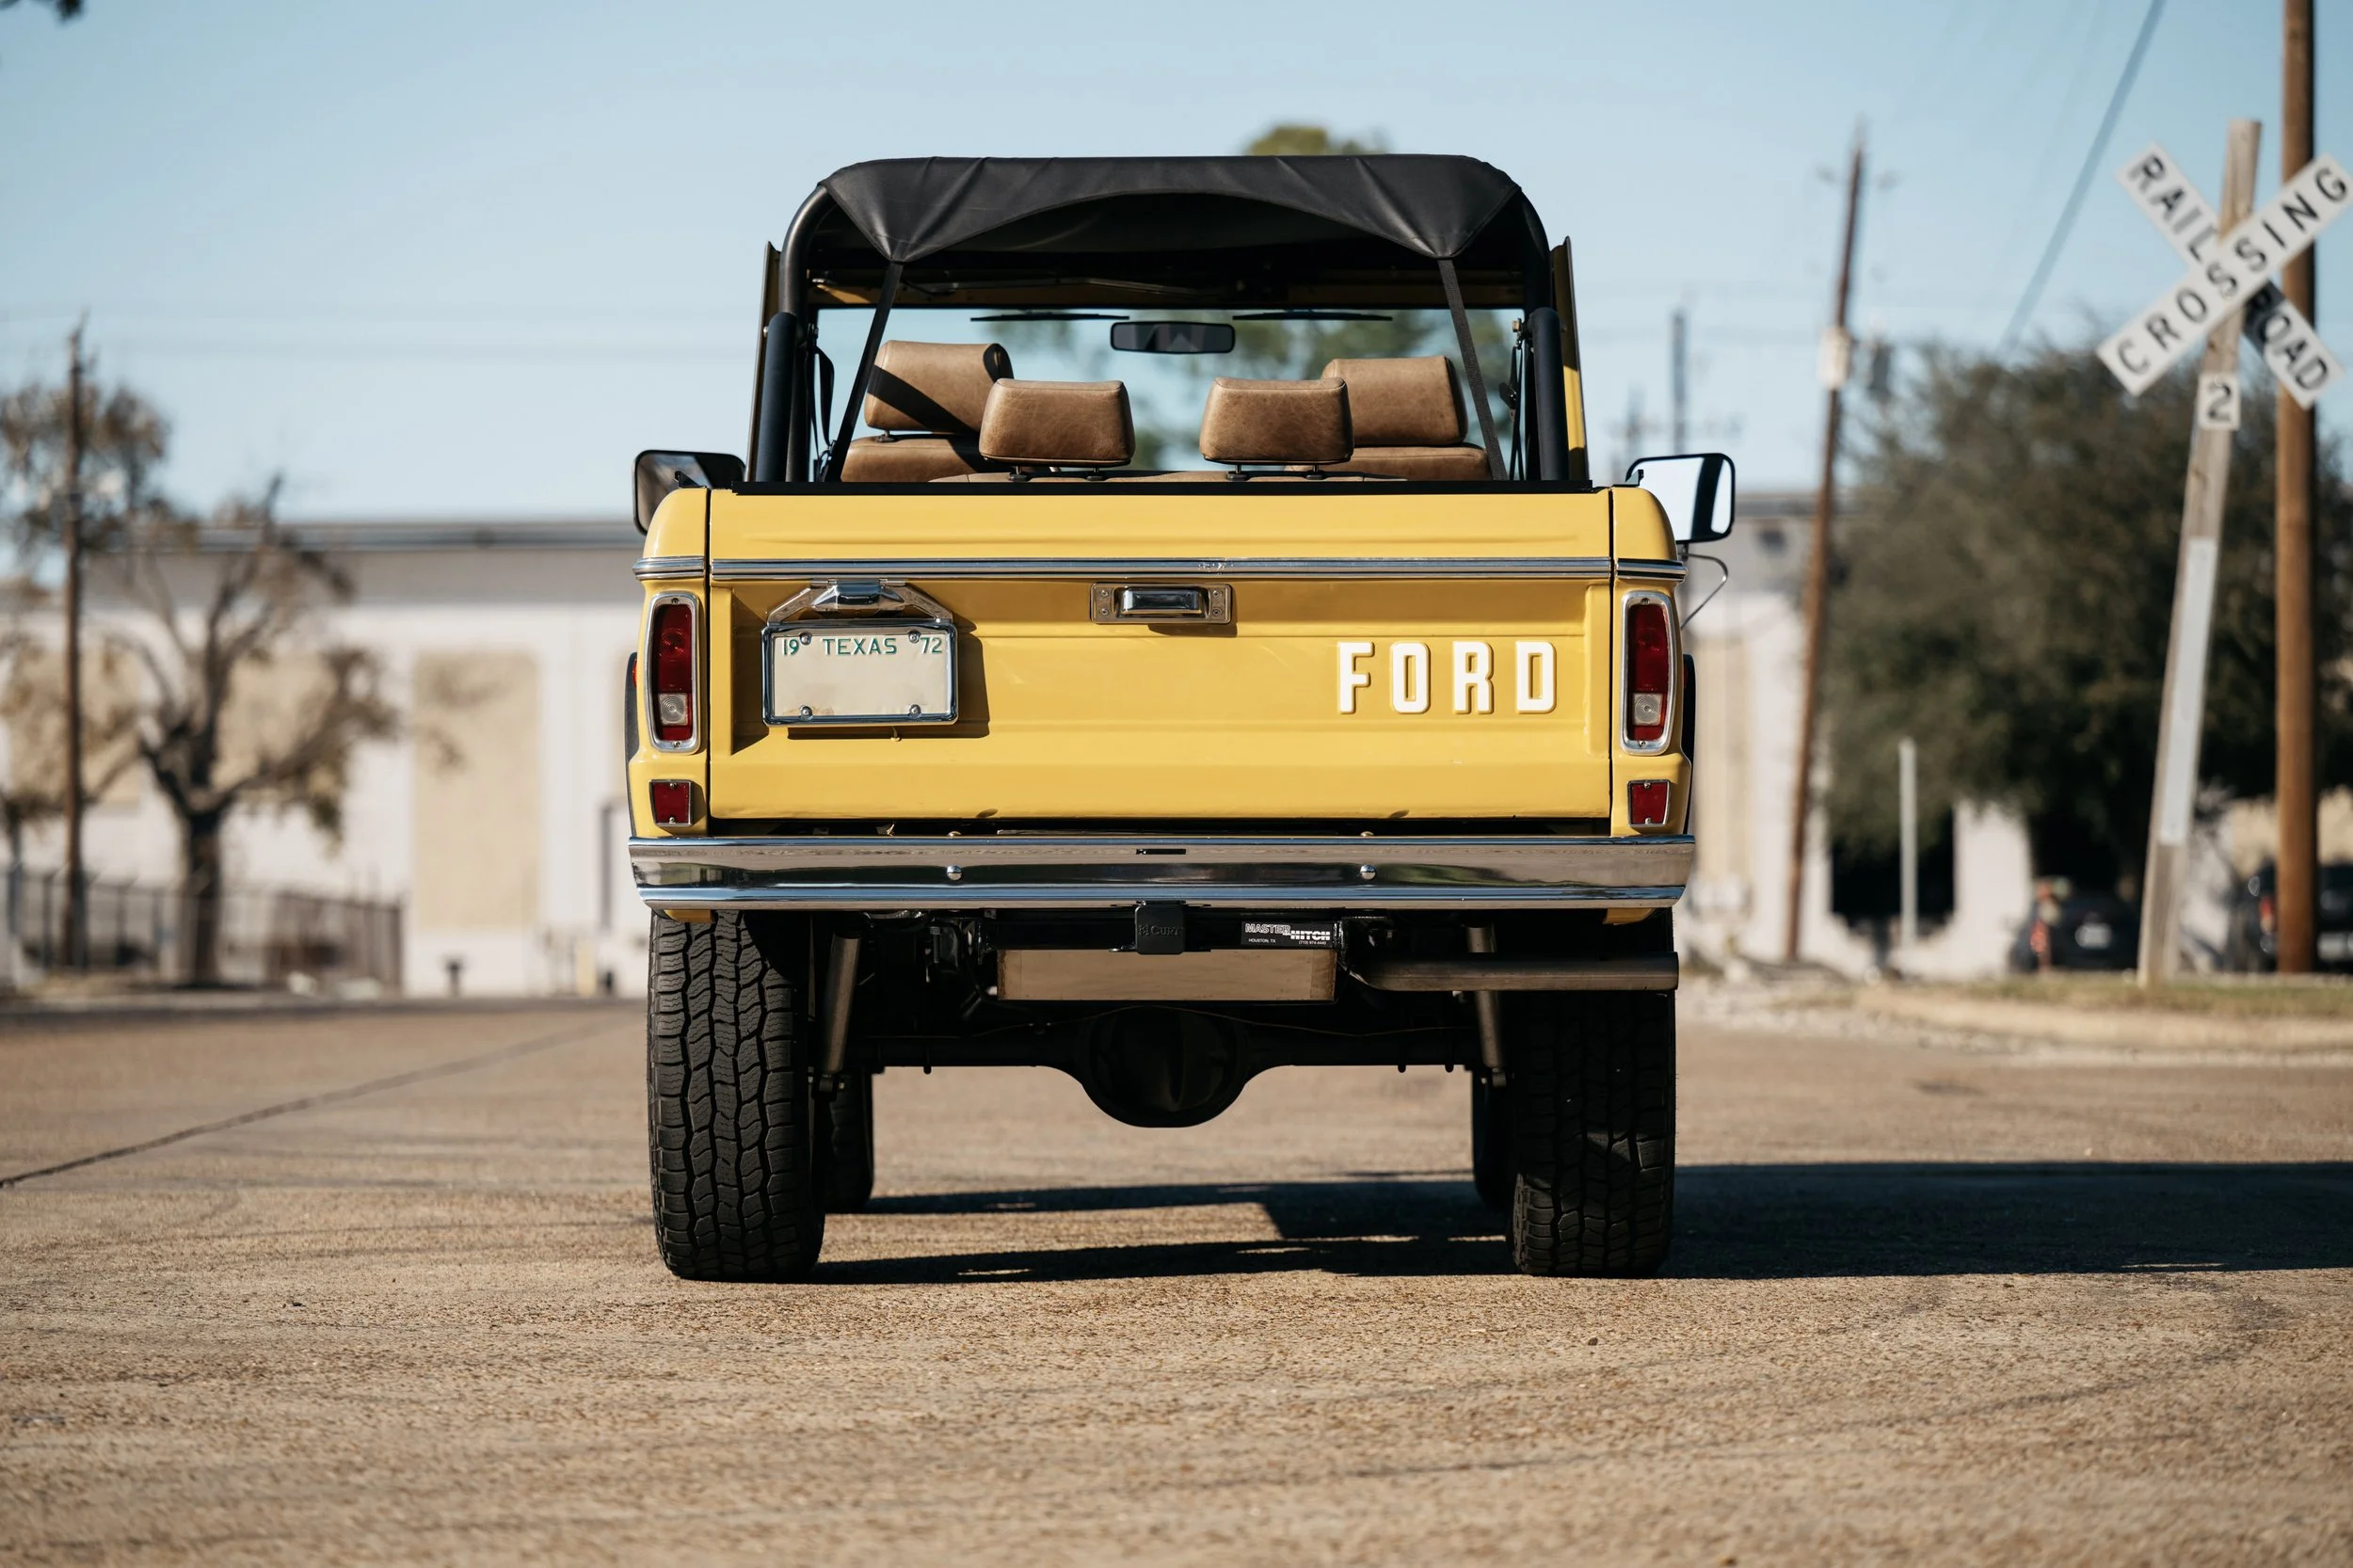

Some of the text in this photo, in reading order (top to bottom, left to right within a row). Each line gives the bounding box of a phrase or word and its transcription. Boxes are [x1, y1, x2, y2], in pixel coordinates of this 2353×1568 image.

[2117, 168, 2348, 376] CROSSING
[2206, 381, 2233, 423] 2
[782, 636, 943, 656] 19 TEXAS 72
[1337, 641, 1558, 714] FORD
[1245, 923, 1290, 935] MASTER
[1290, 930, 1330, 940] HITCH
